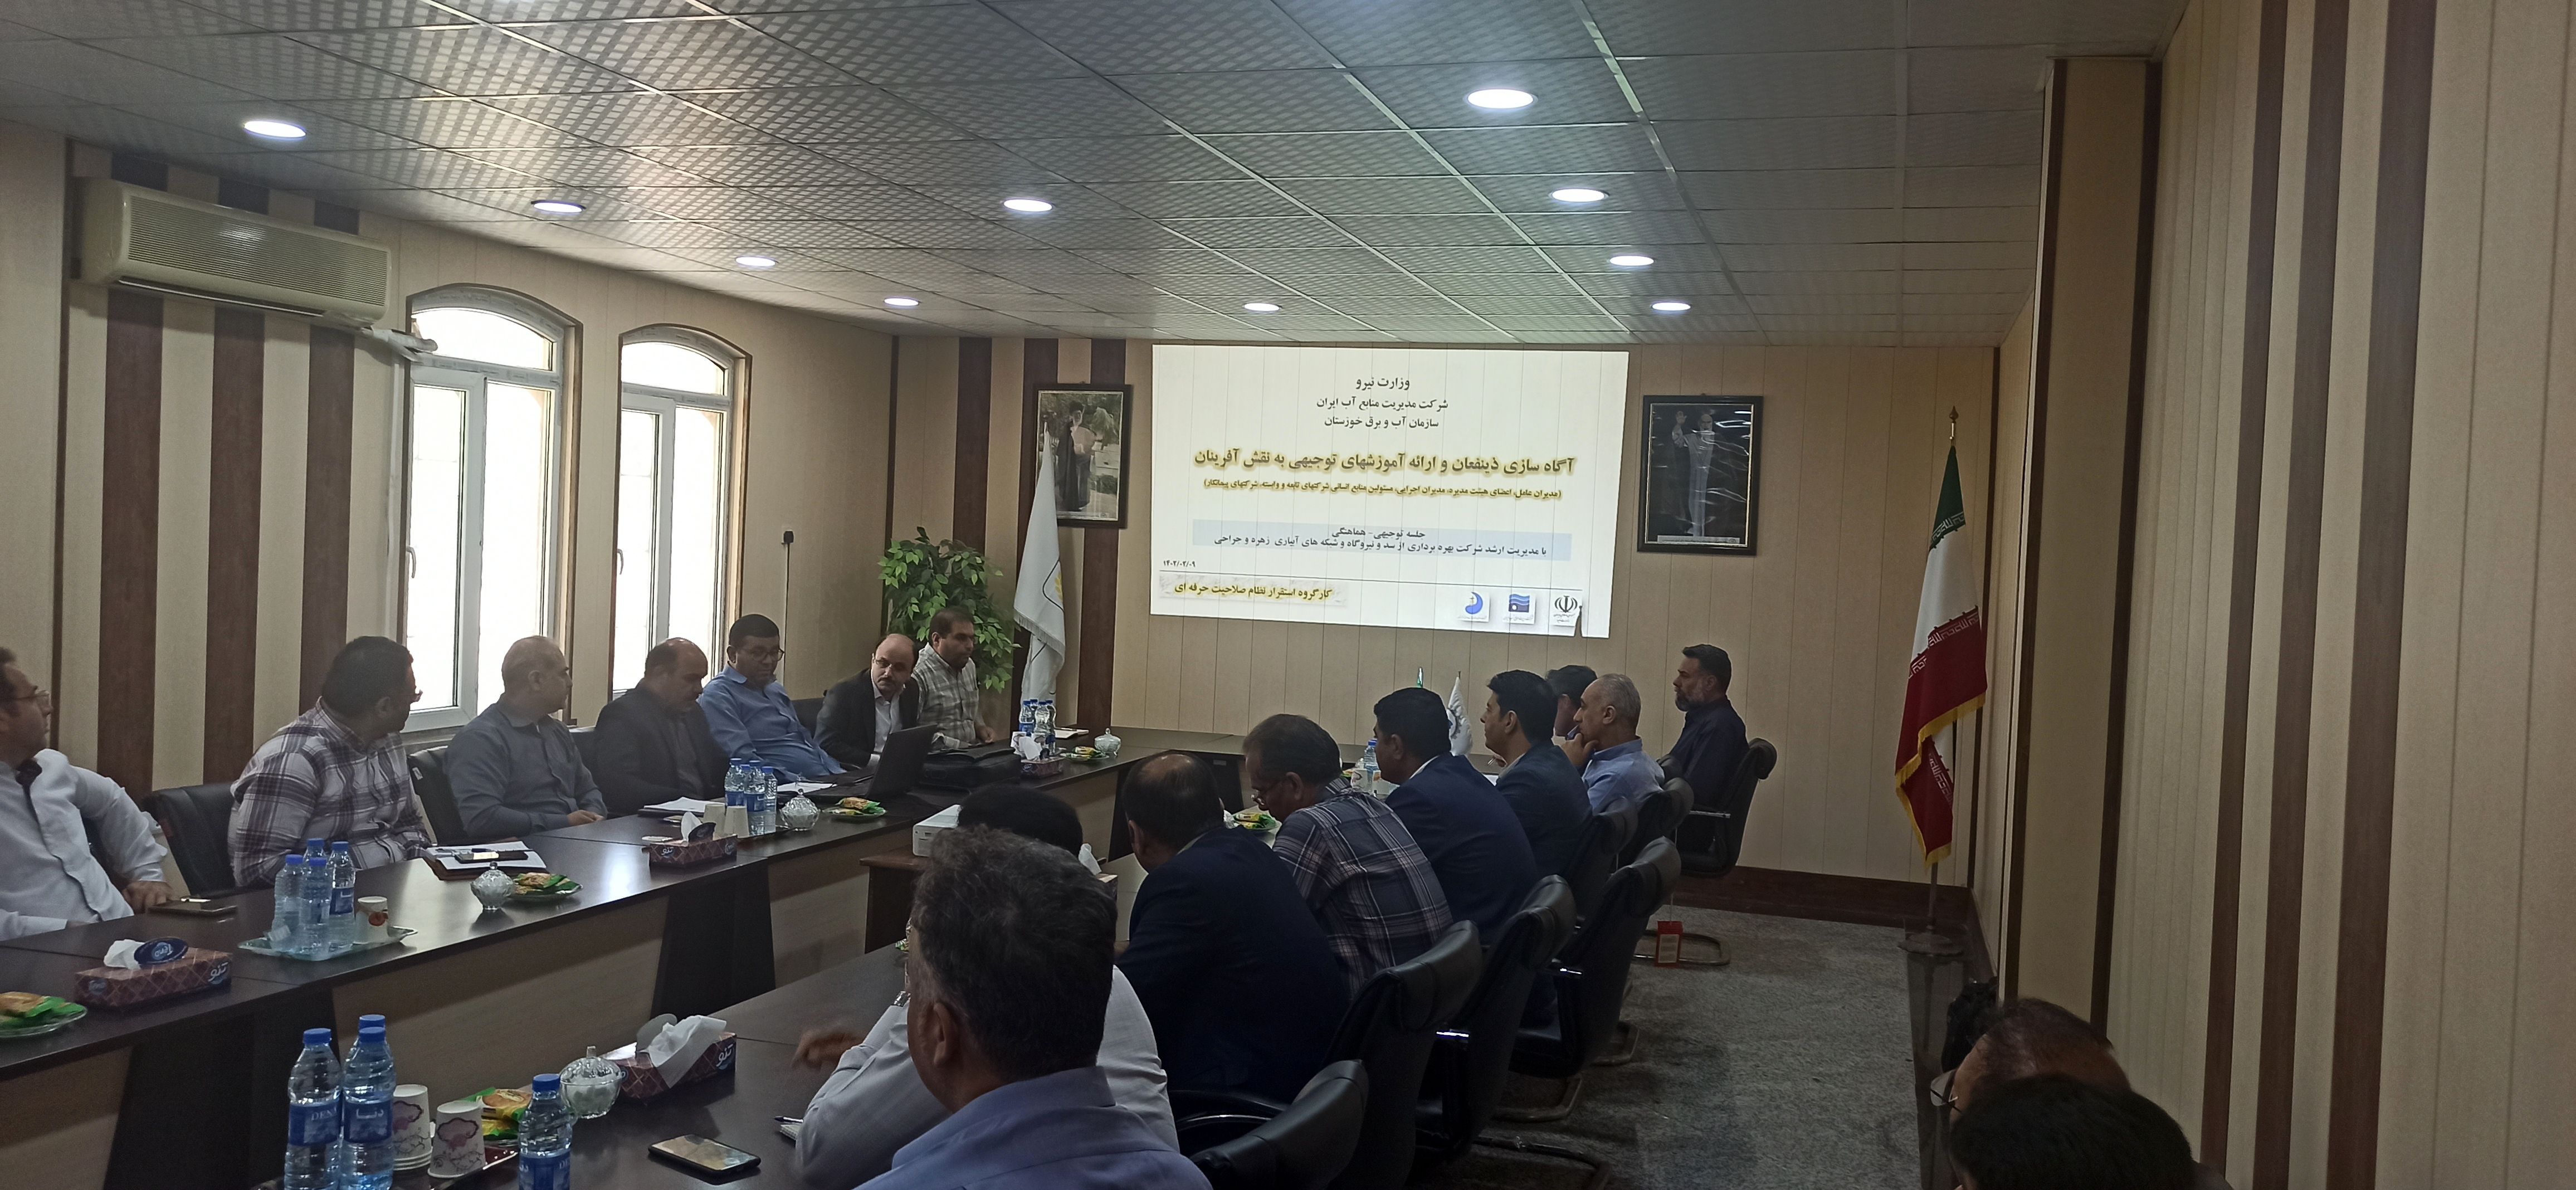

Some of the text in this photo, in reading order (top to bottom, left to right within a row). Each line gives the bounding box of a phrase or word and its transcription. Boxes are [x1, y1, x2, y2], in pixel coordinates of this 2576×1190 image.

[1355, 377, 1410, 391] وزارت نیرو
[1316, 396, 1448, 412] شرکت مدیریت منابع آب ایران
[1324, 416, 1439, 429] سازمان آب و برق خوزستان
[1194, 448, 1575, 474] آگاه سازی ذینفعان و ارائه آموزشهای توجیهی به نقش آفرینان
[1332, 527, 1366, 538] هماهنگی
[1407, 530, 1426, 538] جلسه
[1214, 535, 1242, 545] جراحی
[1251, 535, 1270, 546] زهره
[1275, 535, 1299, 547] آبیاری
[1301, 538, 1318, 547] های
[1320, 538, 1338, 548] شبکه
[1347, 538, 1374, 550] نیروگاه
[1398, 542, 1404, 551] از
[1408, 543, 1436, 553] برداری
[1438, 545, 1453, 554] بهره
[1456, 544, 1482, 555] شرکت
[1485, 545, 1504, 554] ارشد
[1507, 547, 1539, 557] مدیریت
[1541, 547, 1546, 556] با
[1174, 583, 1186, 593] ای
[1188, 583, 1209, 596] حرفه
[1211, 584, 1247, 597] صلاحیت
[1248, 586, 1266, 598] نظام
[1269, 587, 1295, 599] استقرار
[208, 962, 229, 982] تنو
[716, 1043, 734, 1067] تنو
